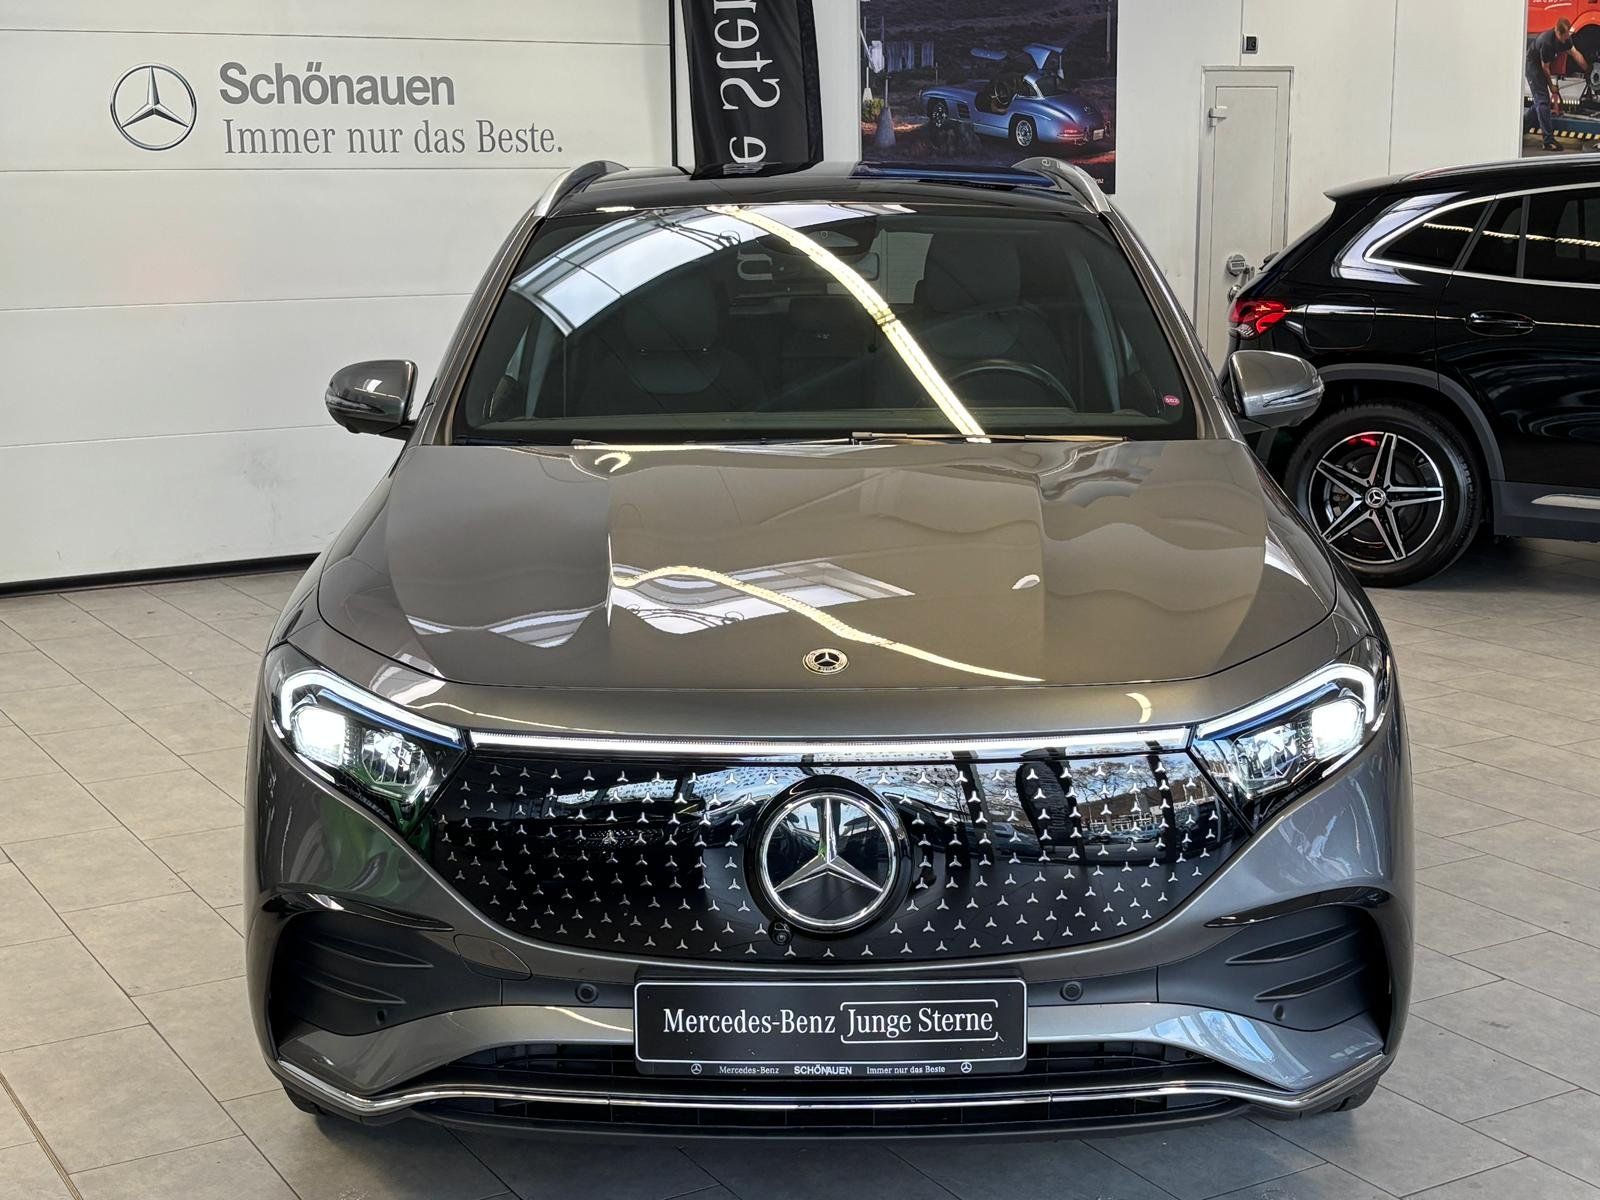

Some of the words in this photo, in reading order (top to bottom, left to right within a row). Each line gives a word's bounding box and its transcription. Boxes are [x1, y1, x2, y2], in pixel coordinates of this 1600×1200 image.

[219, 61, 455, 106] Schönauen
[222, 118, 336, 154] Immer
[346, 128, 404, 154] nur
[413, 119, 466, 154] das
[475, 119, 563, 154] Beste.
[663, 1008, 836, 1034] Mercedes-Benz
[846, 1008, 912, 1038] Junge
[918, 1007, 993, 1033] Sterne
[718, 1065, 780, 1075] Mercedes-Benz
[793, 1064, 853, 1076] SCHÖNAUEN
[866, 1066, 893, 1075] Immer
[894, 1066, 908, 1075] nur
[909, 1065, 923, 1074] das
[925, 1065, 946, 1074] Beste
